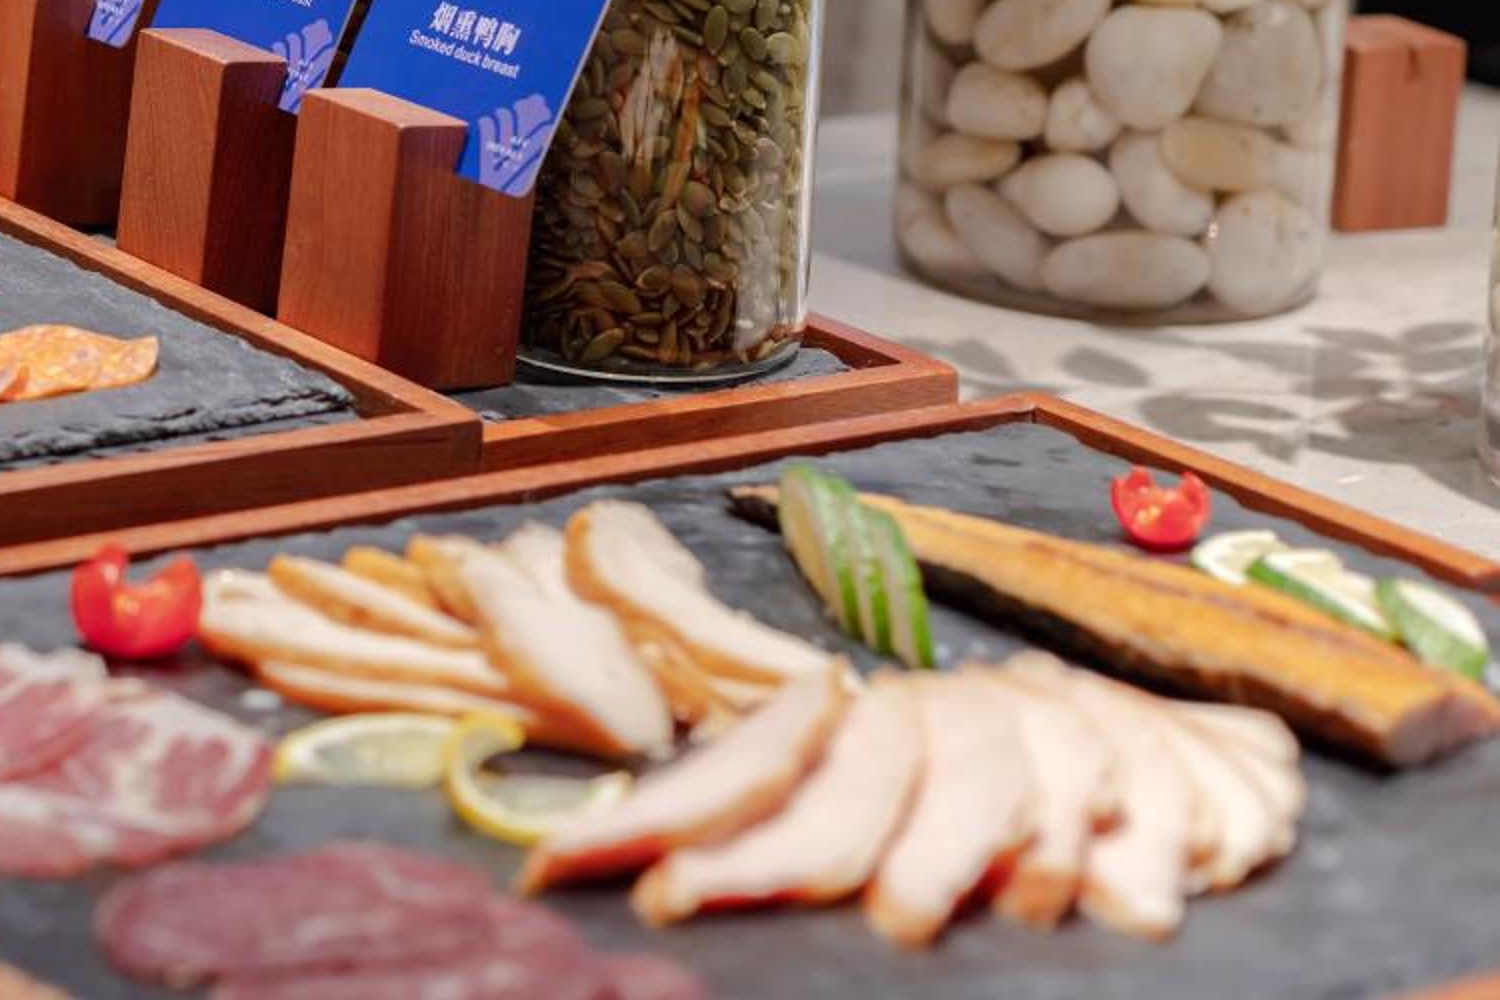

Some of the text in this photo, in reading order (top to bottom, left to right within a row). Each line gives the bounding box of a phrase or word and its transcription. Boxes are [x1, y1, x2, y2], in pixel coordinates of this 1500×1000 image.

[410, 30, 521, 80] Smoked duck breast
